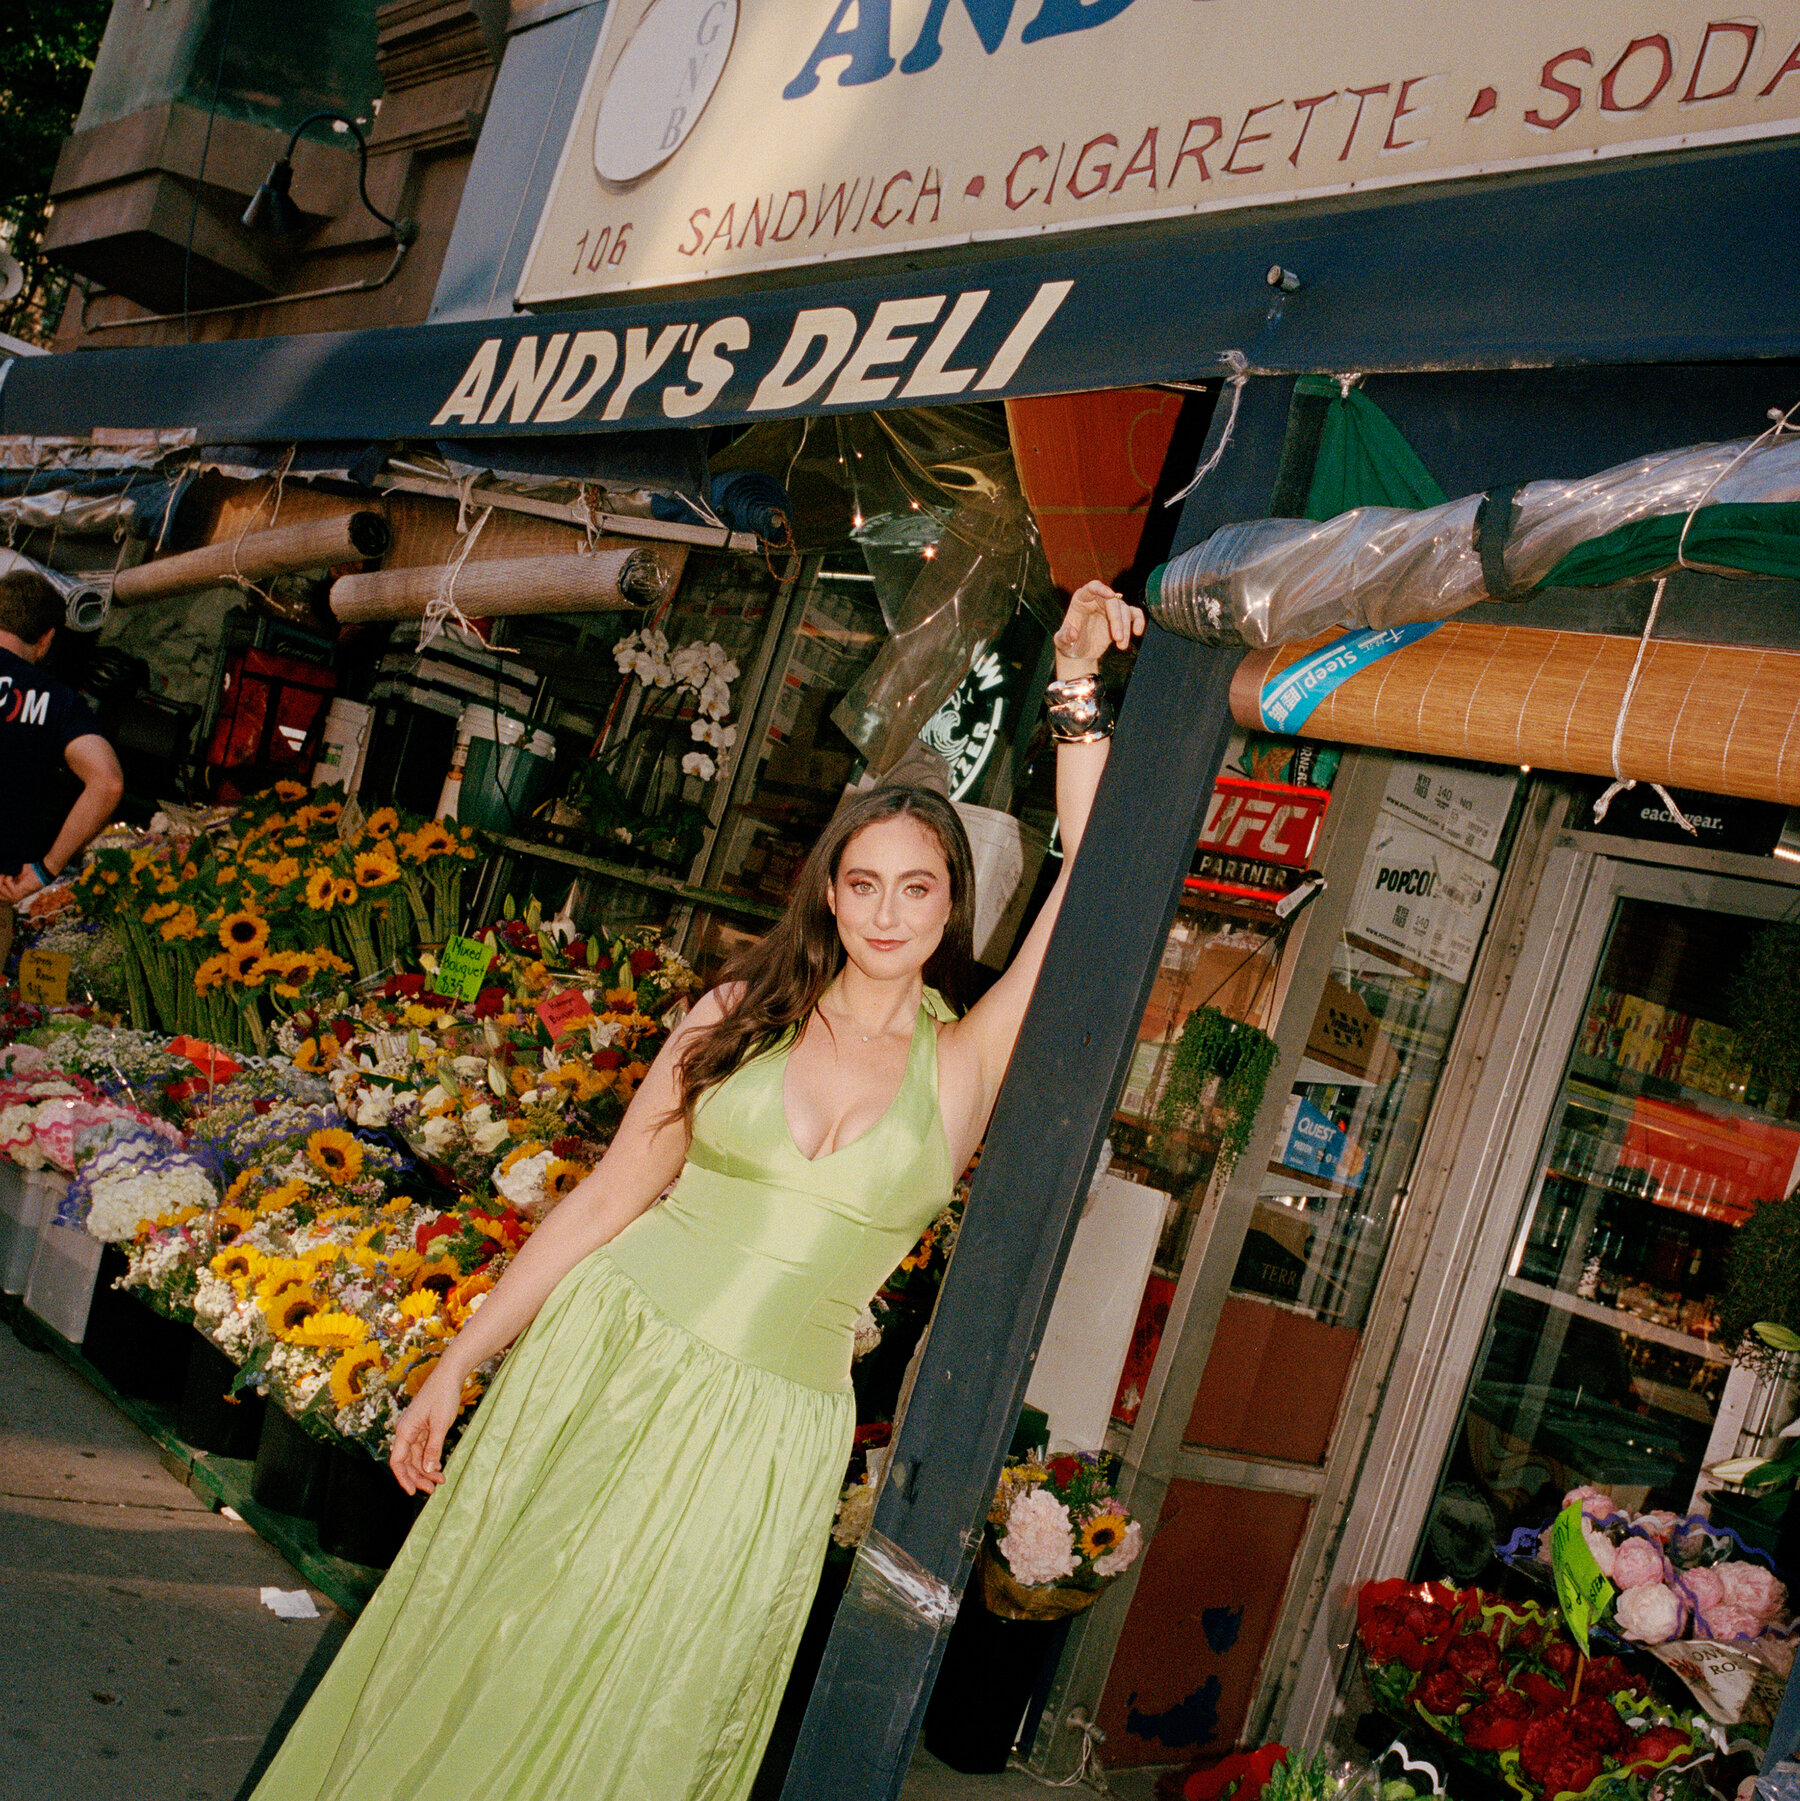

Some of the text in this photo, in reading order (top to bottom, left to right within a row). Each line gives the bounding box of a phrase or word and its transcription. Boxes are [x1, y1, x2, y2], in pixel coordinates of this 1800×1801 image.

[677, 165, 943, 257] SANDWICH
[1004, 75, 1442, 211] CIGARETTE
[572, 222, 634, 276] 106
[430, 279, 1075, 426] ANDY'S DELI
[1303, 649, 1358, 689] Sleep
[1199, 792, 1309, 856] UFC
[1199, 855, 1288, 887] PARTNER
[442, 952, 485, 979] Bouquet
[452, 937, 483, 961] Mixed
[1297, 1116, 1337, 1143] QUEST
